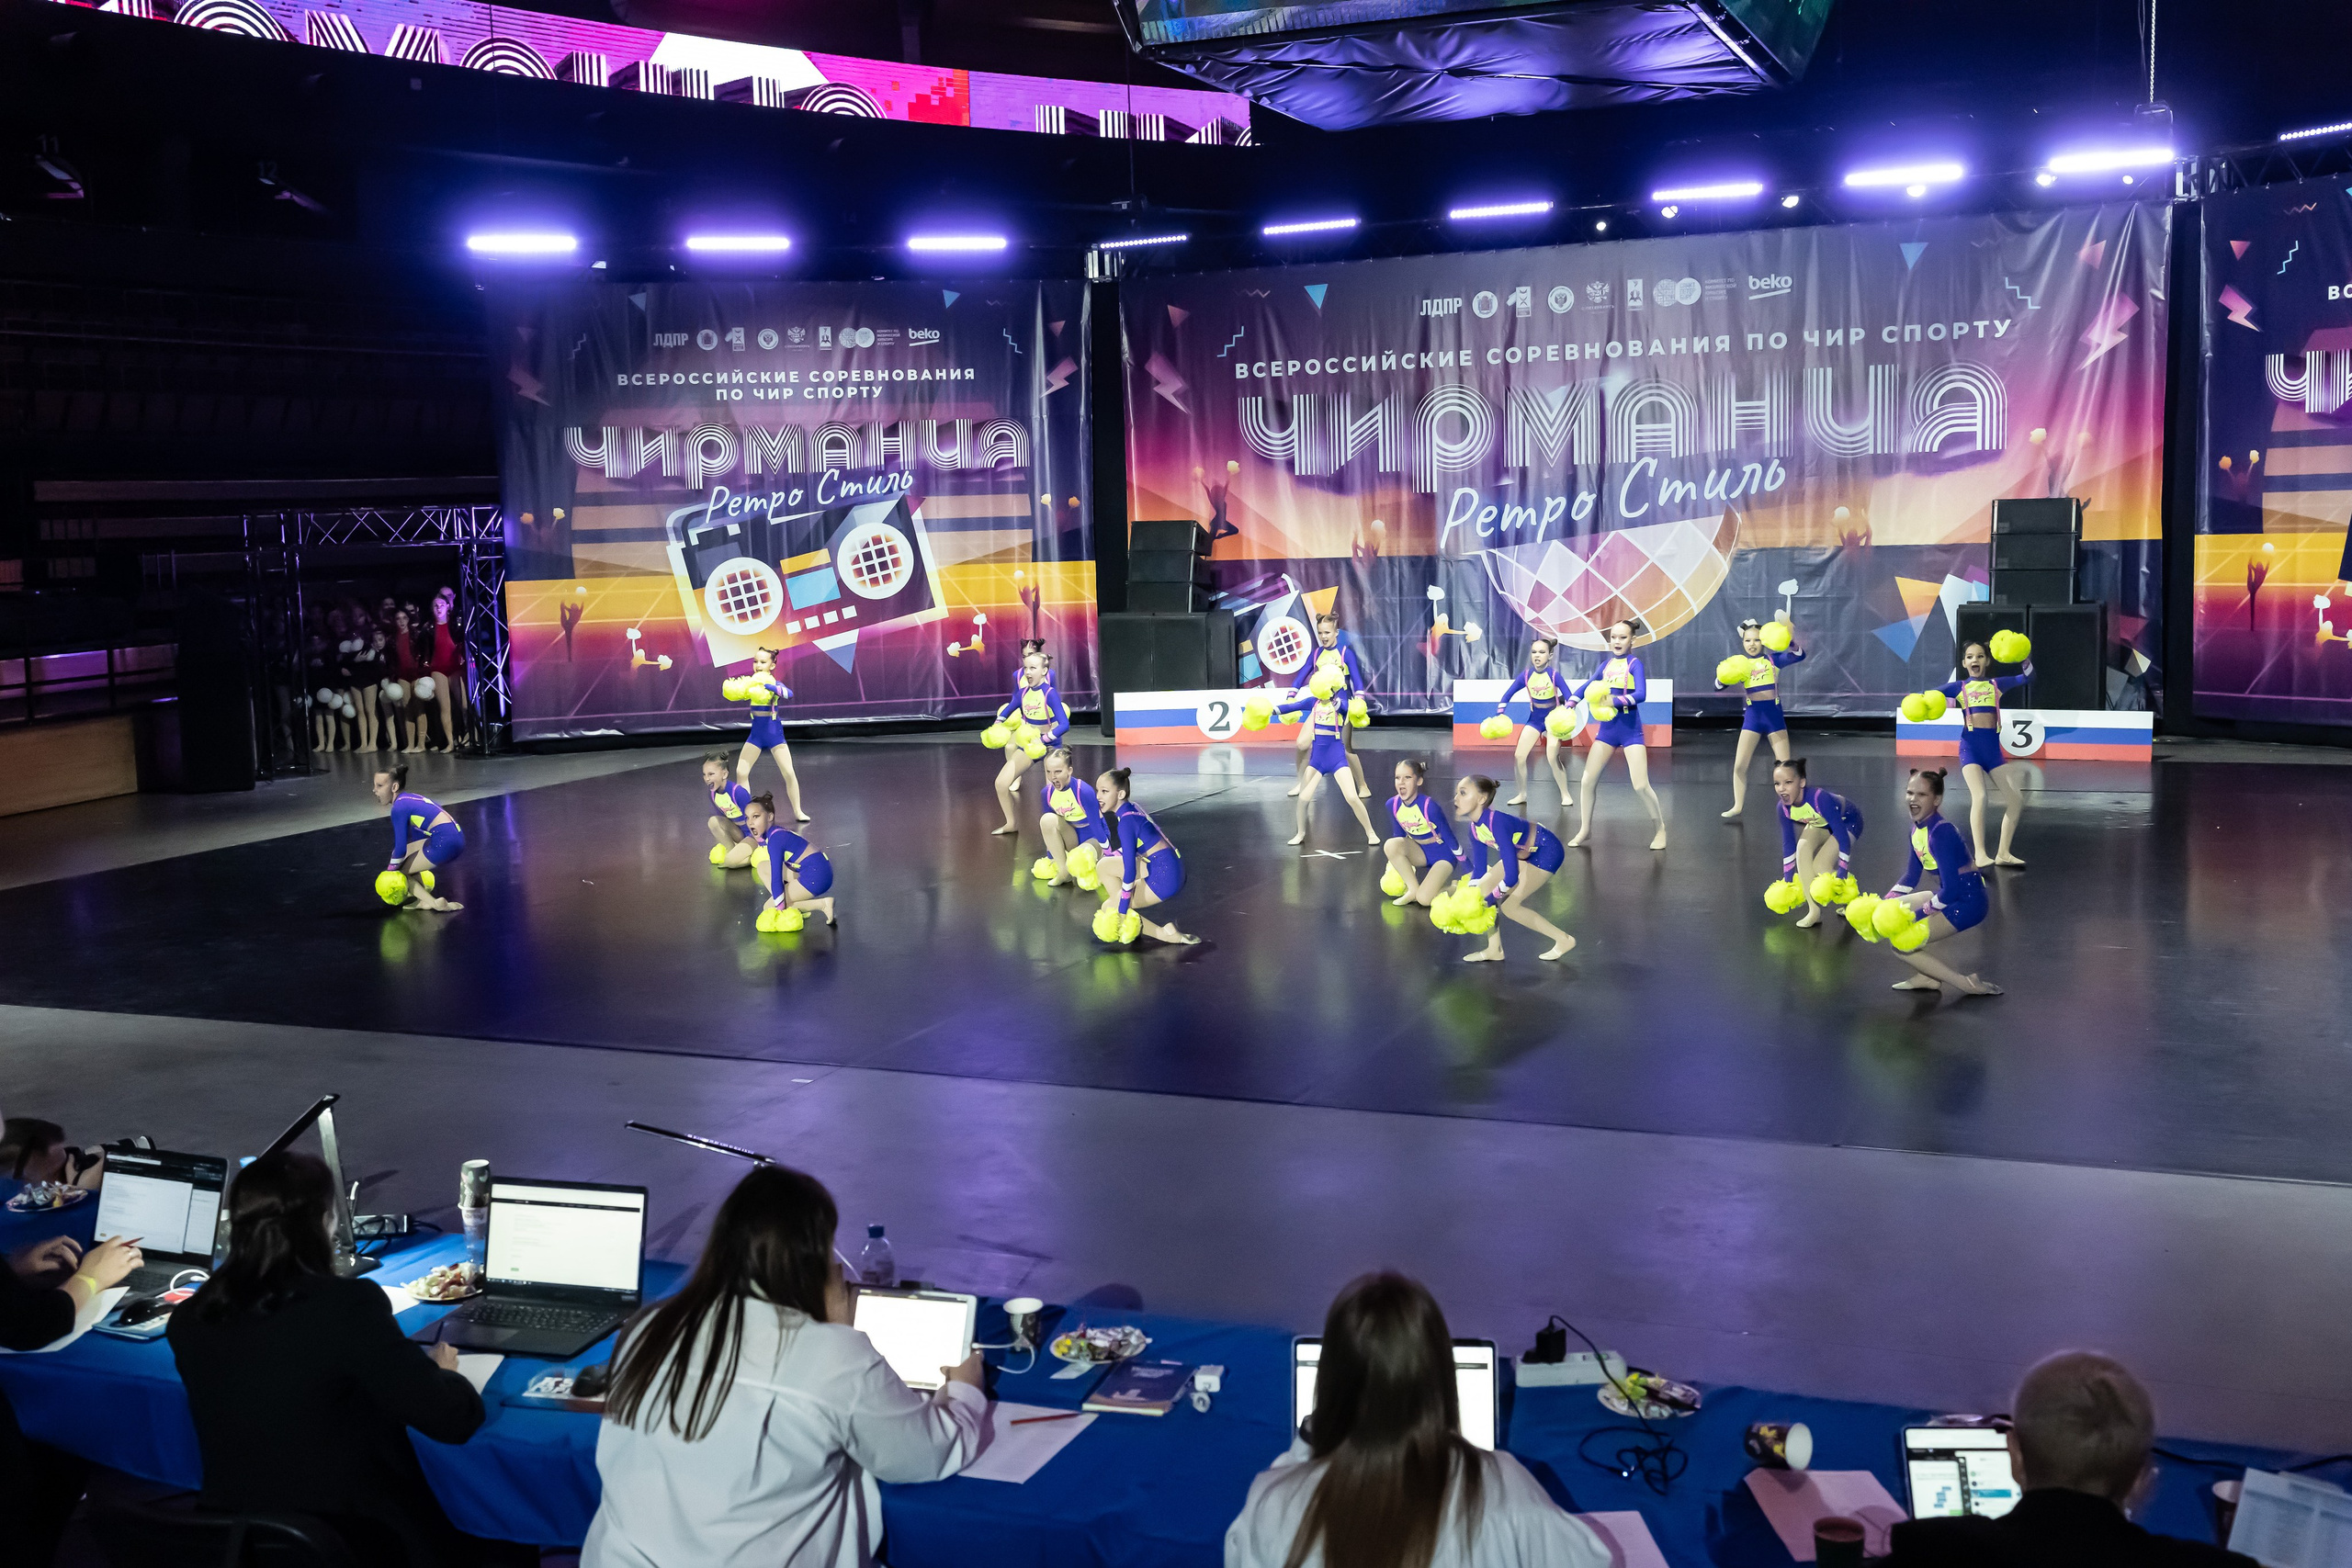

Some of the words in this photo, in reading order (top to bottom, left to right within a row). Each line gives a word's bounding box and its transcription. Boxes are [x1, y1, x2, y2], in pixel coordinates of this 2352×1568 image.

[1747, 274, 1792, 290] beko
[1419, 298, 1463, 318] ЛДПР
[653, 333, 689, 348] ЛДПР
[908, 328, 941, 340] beko
[1235, 349, 1473, 379] ВСЕРОССИЙСКИЕ
[1487, 334, 1731, 365] СОРЕВНОВАНИЯ
[1747, 332, 1788, 351] ПО
[1804, 326, 1866, 347] ЧИР
[1882, 318, 2013, 344] СПОРТУ
[617, 368, 800, 386] ВСЕРОССИЙСКИЕ
[808, 367, 976, 383] СОРЕВНОВАНИЯ
[716, 388, 743, 400] ПО
[754, 387, 795, 400] ЧИР
[803, 386, 883, 400] СПОРТУ
[706, 485, 804, 524] Ретро
[817, 468, 914, 505] Стиль
[1440, 487, 1597, 549] Ретро
[1619, 457, 1787, 519] Стиль
[1208, 701, 1231, 733] 2
[2011, 719, 2033, 749] 3
